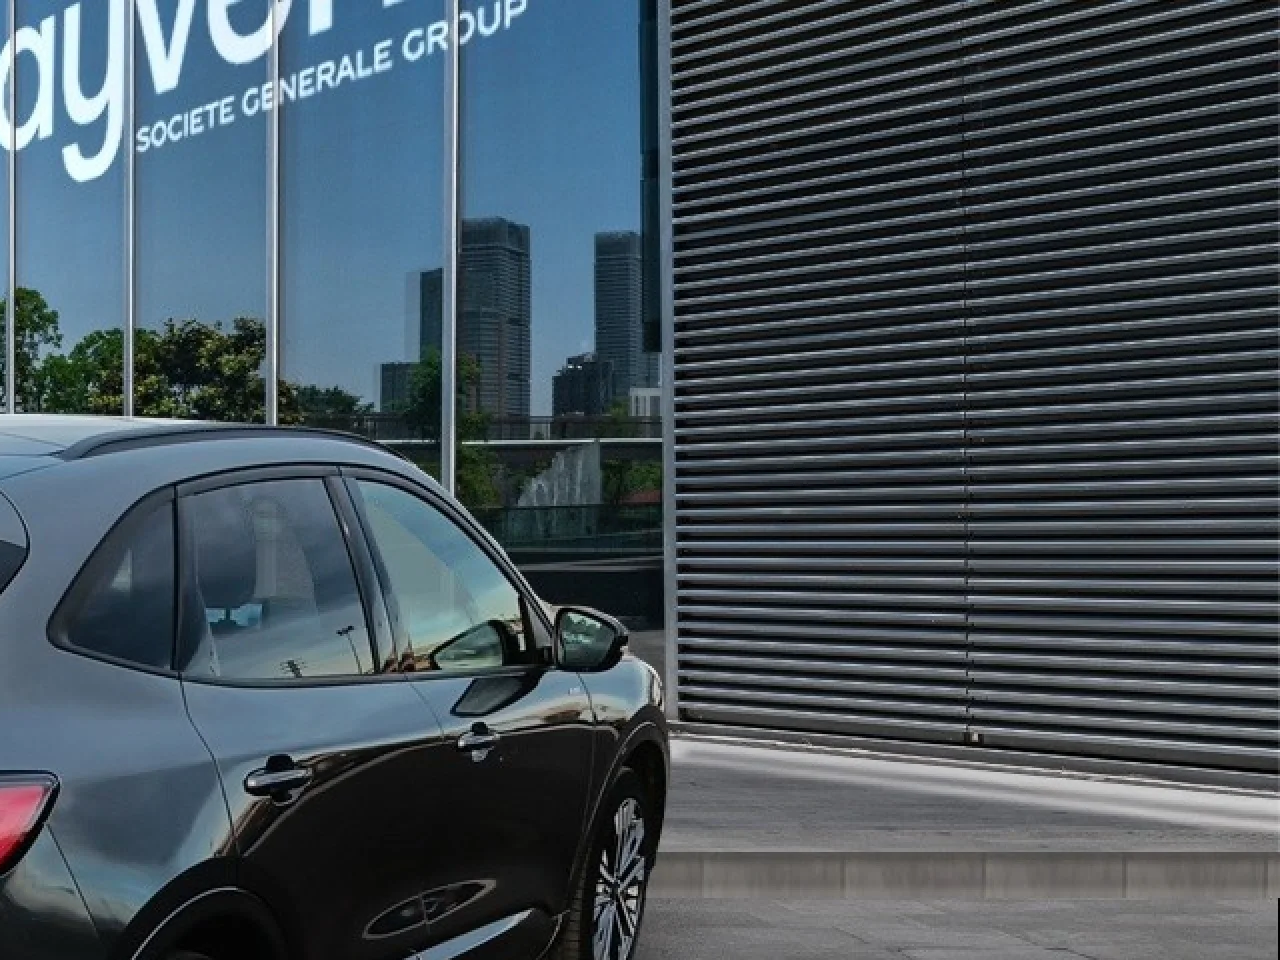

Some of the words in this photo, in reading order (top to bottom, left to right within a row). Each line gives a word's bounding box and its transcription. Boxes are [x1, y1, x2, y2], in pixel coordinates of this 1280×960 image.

[135, 94, 234, 152] SOCIETE
[241, 38, 393, 116] GENERALE
[401, 0, 527, 62] GROUP
